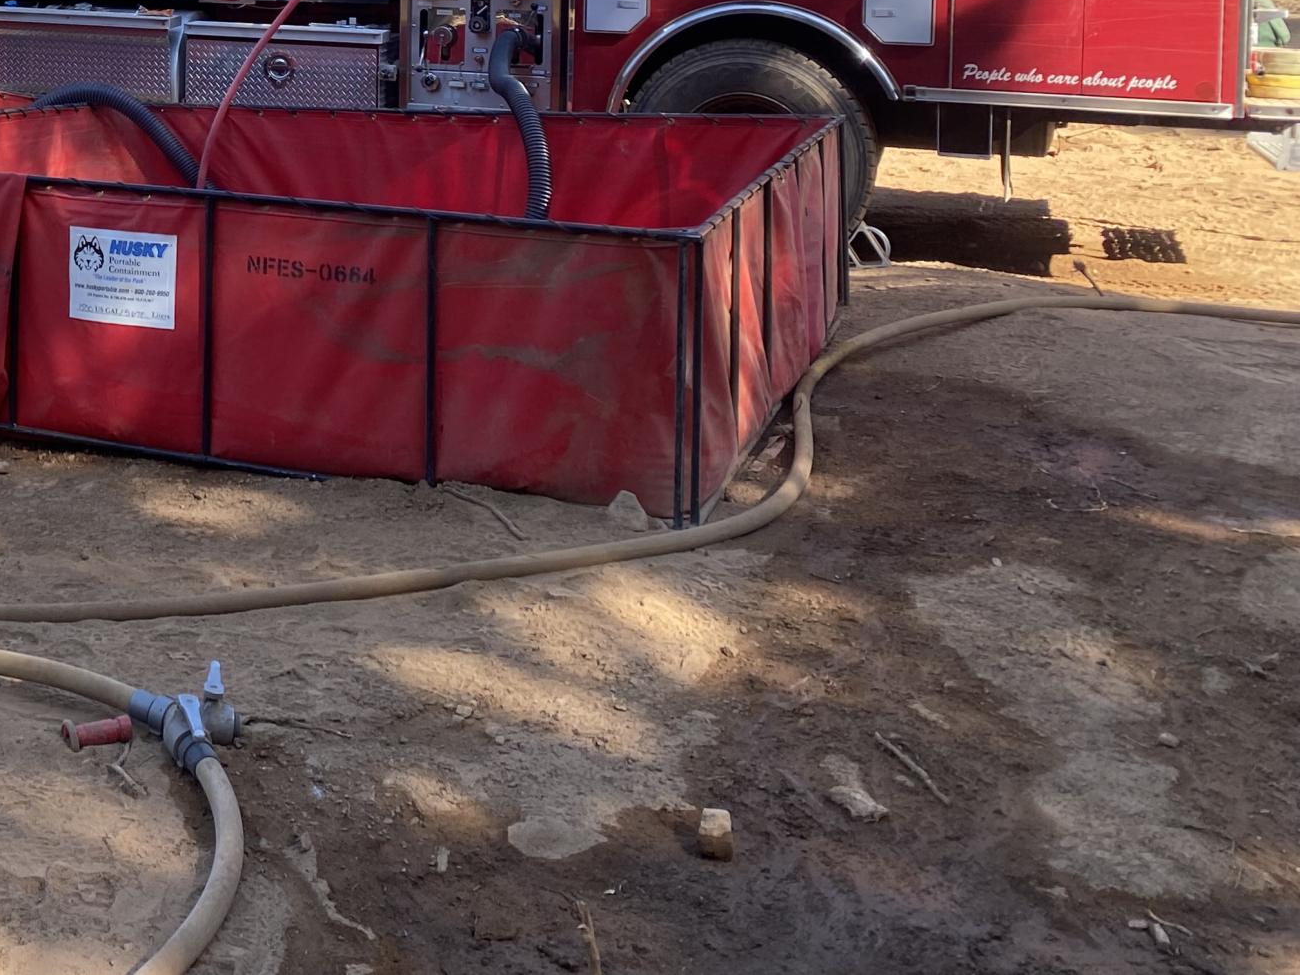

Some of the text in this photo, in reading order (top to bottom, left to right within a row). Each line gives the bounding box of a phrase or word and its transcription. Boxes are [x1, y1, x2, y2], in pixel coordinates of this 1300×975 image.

[963, 64, 1178, 93] People who care about people
[109, 239, 169, 258] HUSKY
[108, 256, 141, 267] Portable
[108, 265, 161, 277] Containment
[247, 255, 377, 284] NFES-0664
